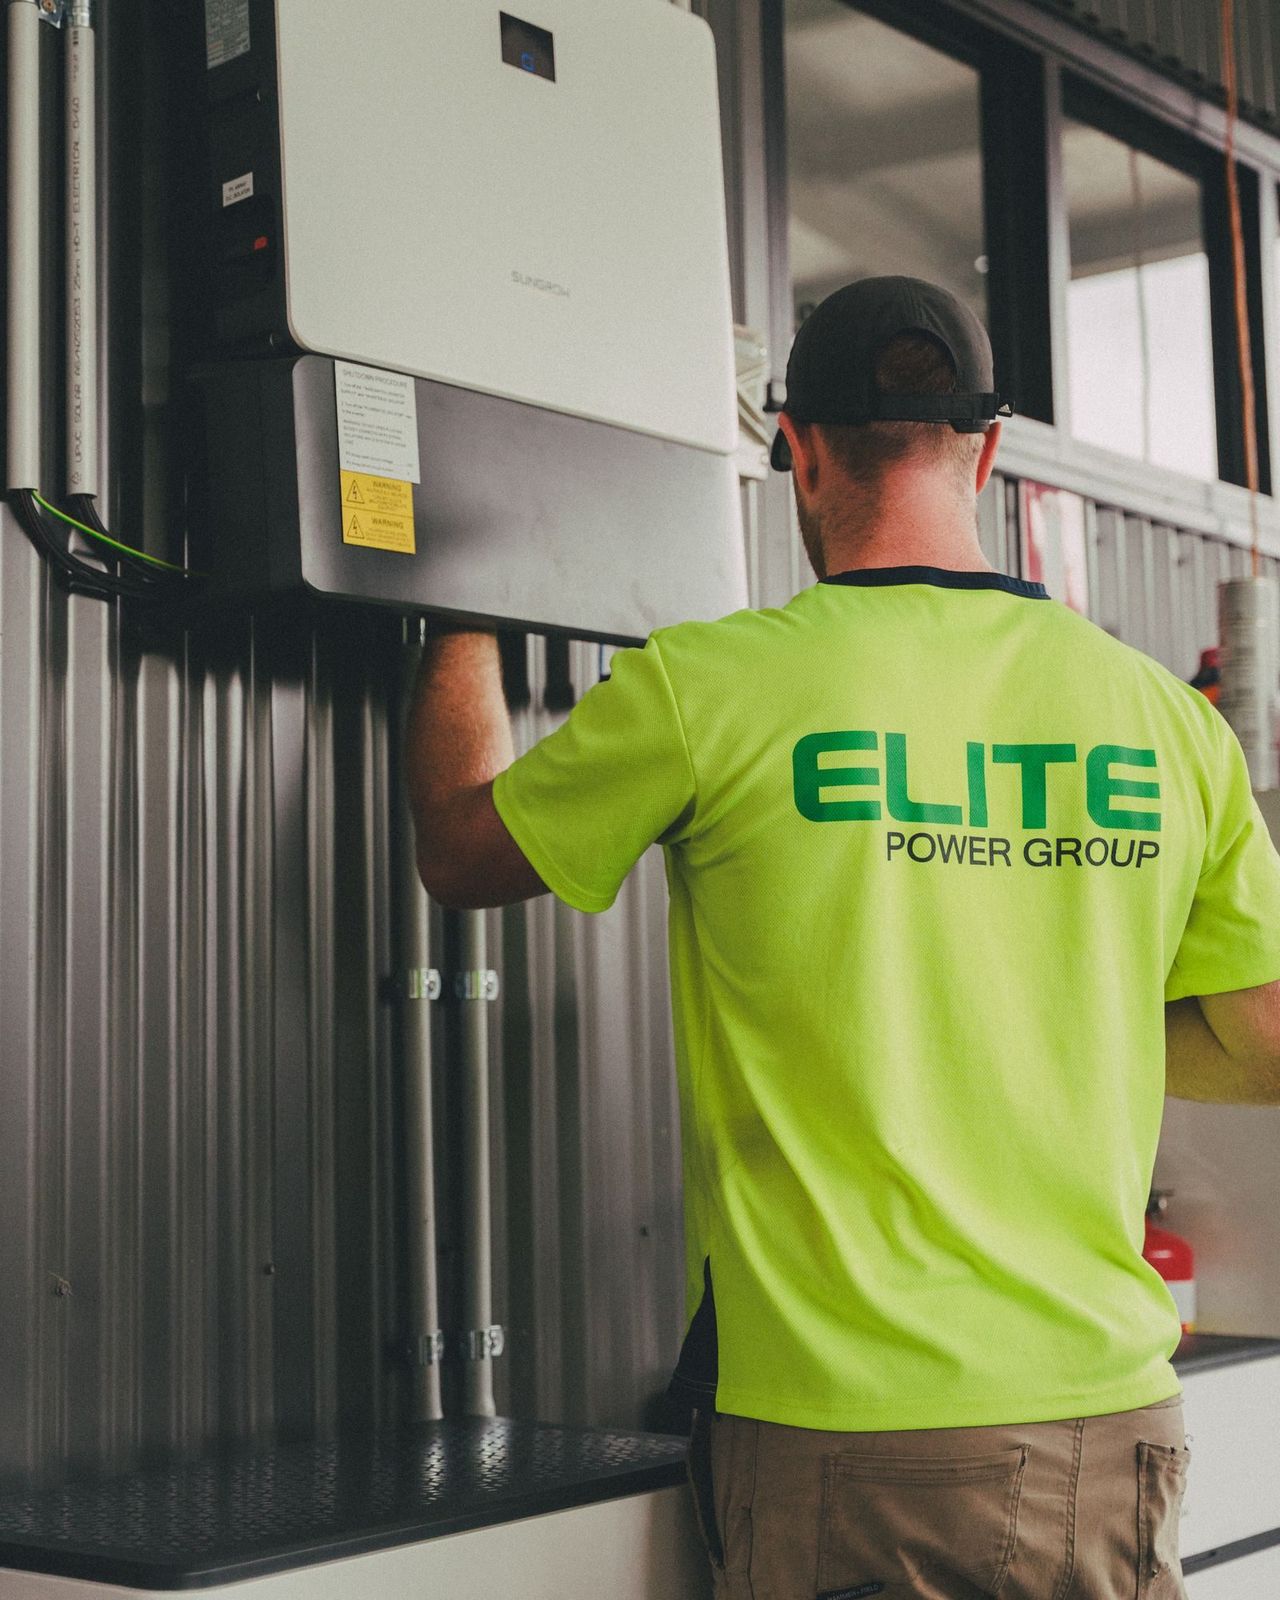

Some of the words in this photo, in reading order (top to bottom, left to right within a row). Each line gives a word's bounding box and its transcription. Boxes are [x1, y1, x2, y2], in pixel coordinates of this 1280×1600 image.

[72, 141, 81, 214] ELECTRICAL
[511, 269, 571, 298] SUNGROW
[73, 384, 82, 424] SOLAR
[371, 480, 402, 493] WARNING
[371, 517, 404, 530] WARNING
[792, 730, 1162, 832] ELITE
[886, 831, 1012, 867] POWER
[1023, 836, 1160, 868] GROUP
